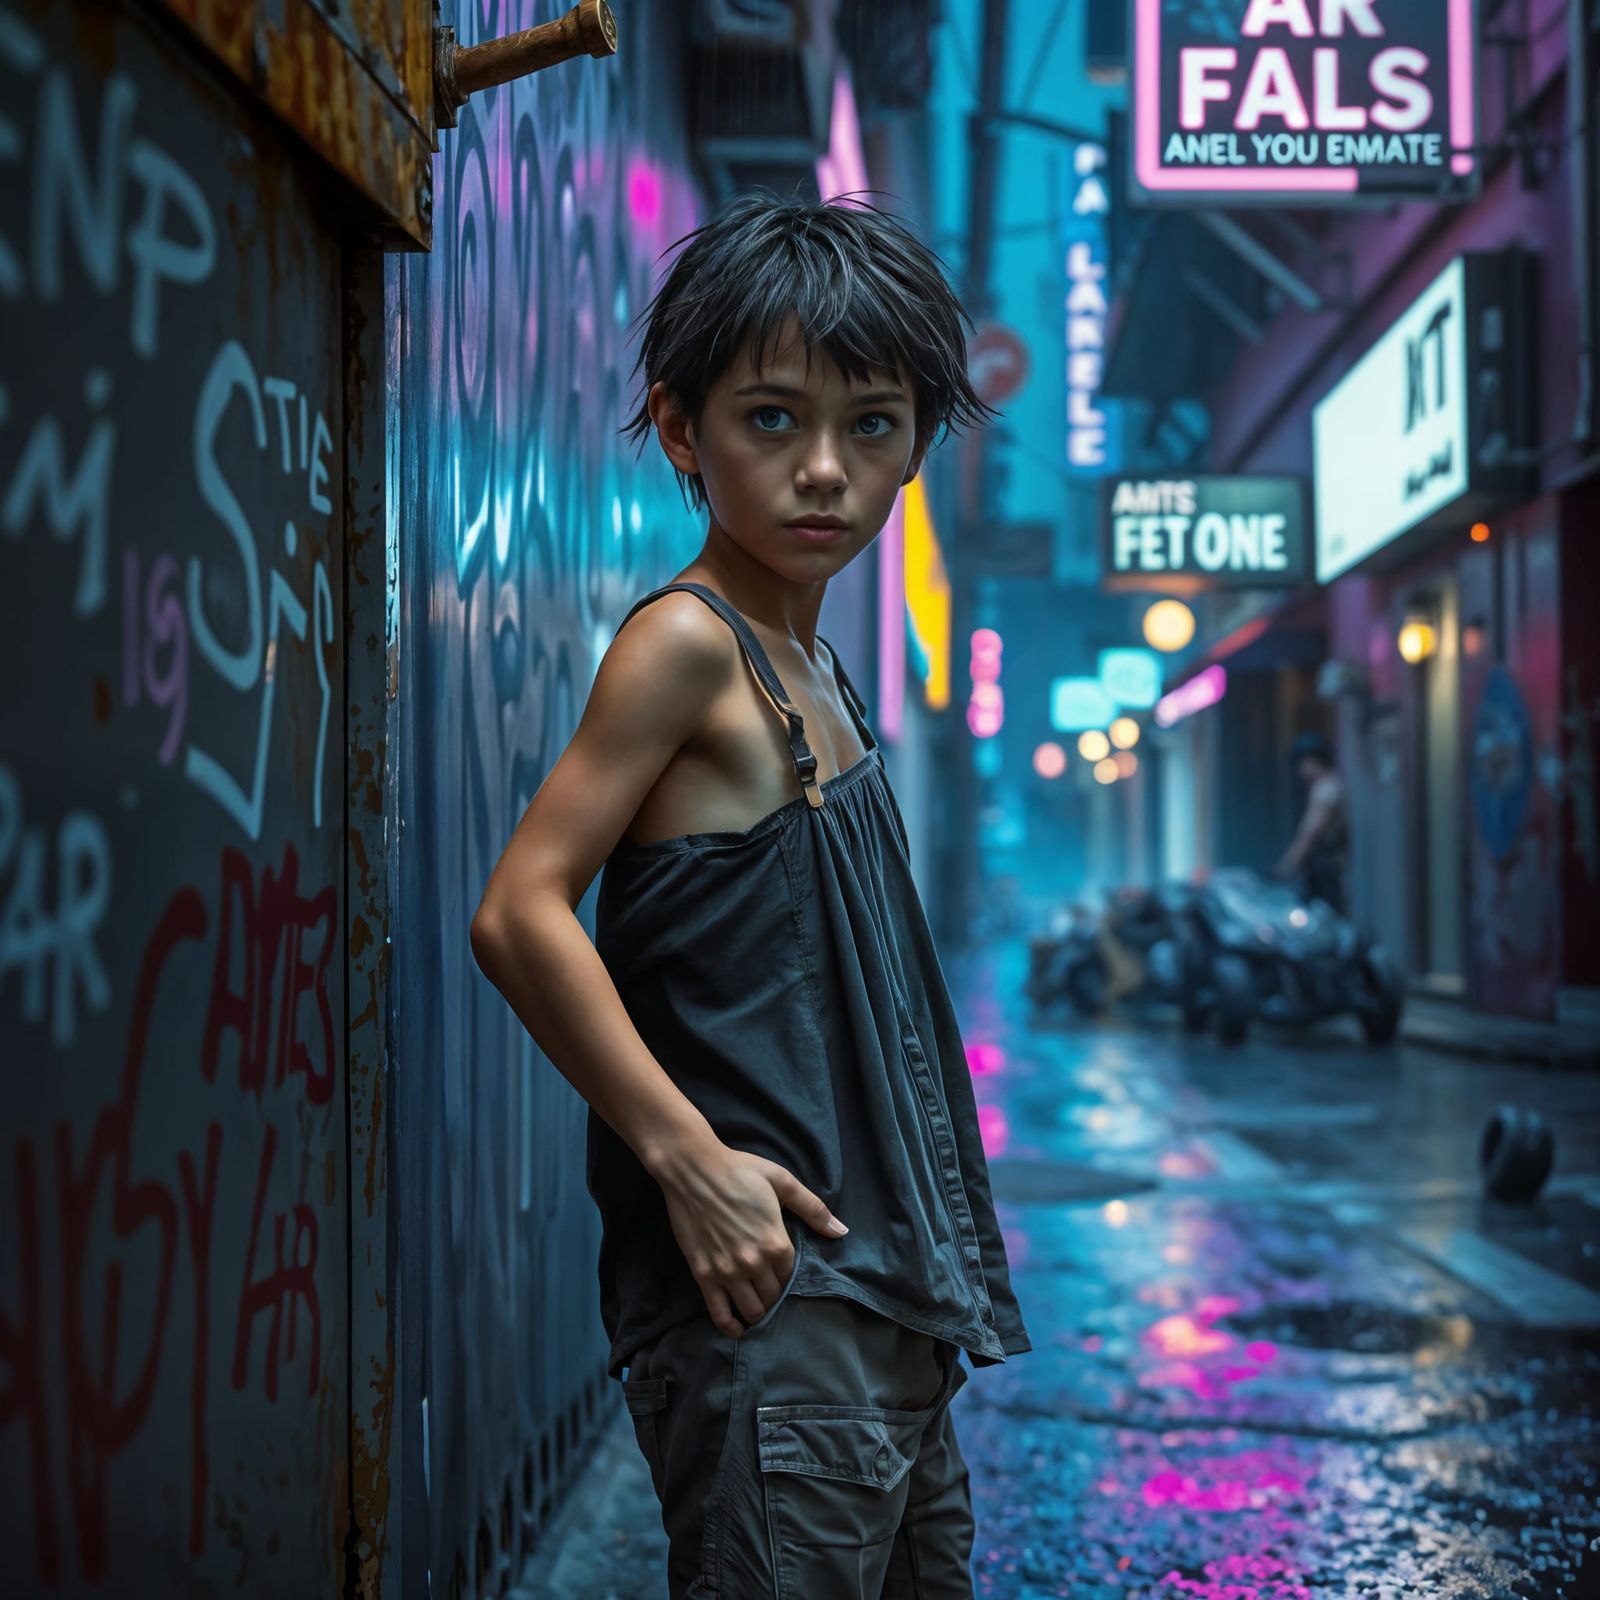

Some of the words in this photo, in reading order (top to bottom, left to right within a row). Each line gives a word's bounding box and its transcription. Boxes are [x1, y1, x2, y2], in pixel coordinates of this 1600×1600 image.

[1179, 47, 1433, 131] FALS
[1163, 132, 1247, 165] ANEL
[1250, 133, 1319, 165] YOU
[1114, 515, 1191, 570] FET
[1192, 512, 1288, 571] ONE
